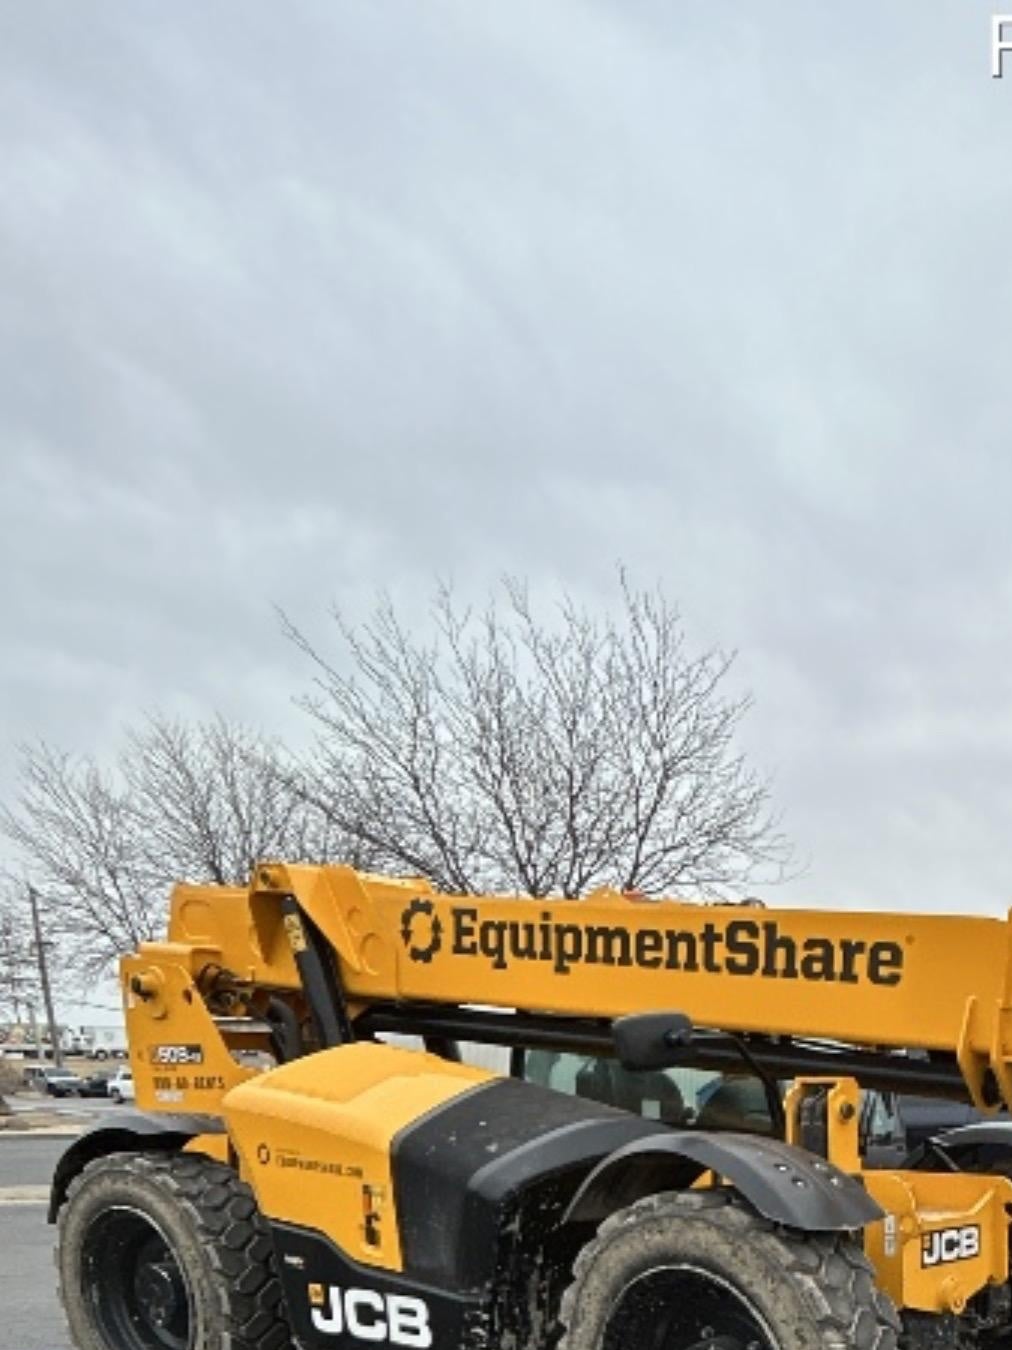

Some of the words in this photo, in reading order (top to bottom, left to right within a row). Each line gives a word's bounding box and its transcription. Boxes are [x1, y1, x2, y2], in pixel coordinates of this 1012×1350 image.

[452, 907, 904, 986] EquipmentShare
[922, 1226, 979, 1265] JCB
[310, 1285, 433, 1348] JCB
